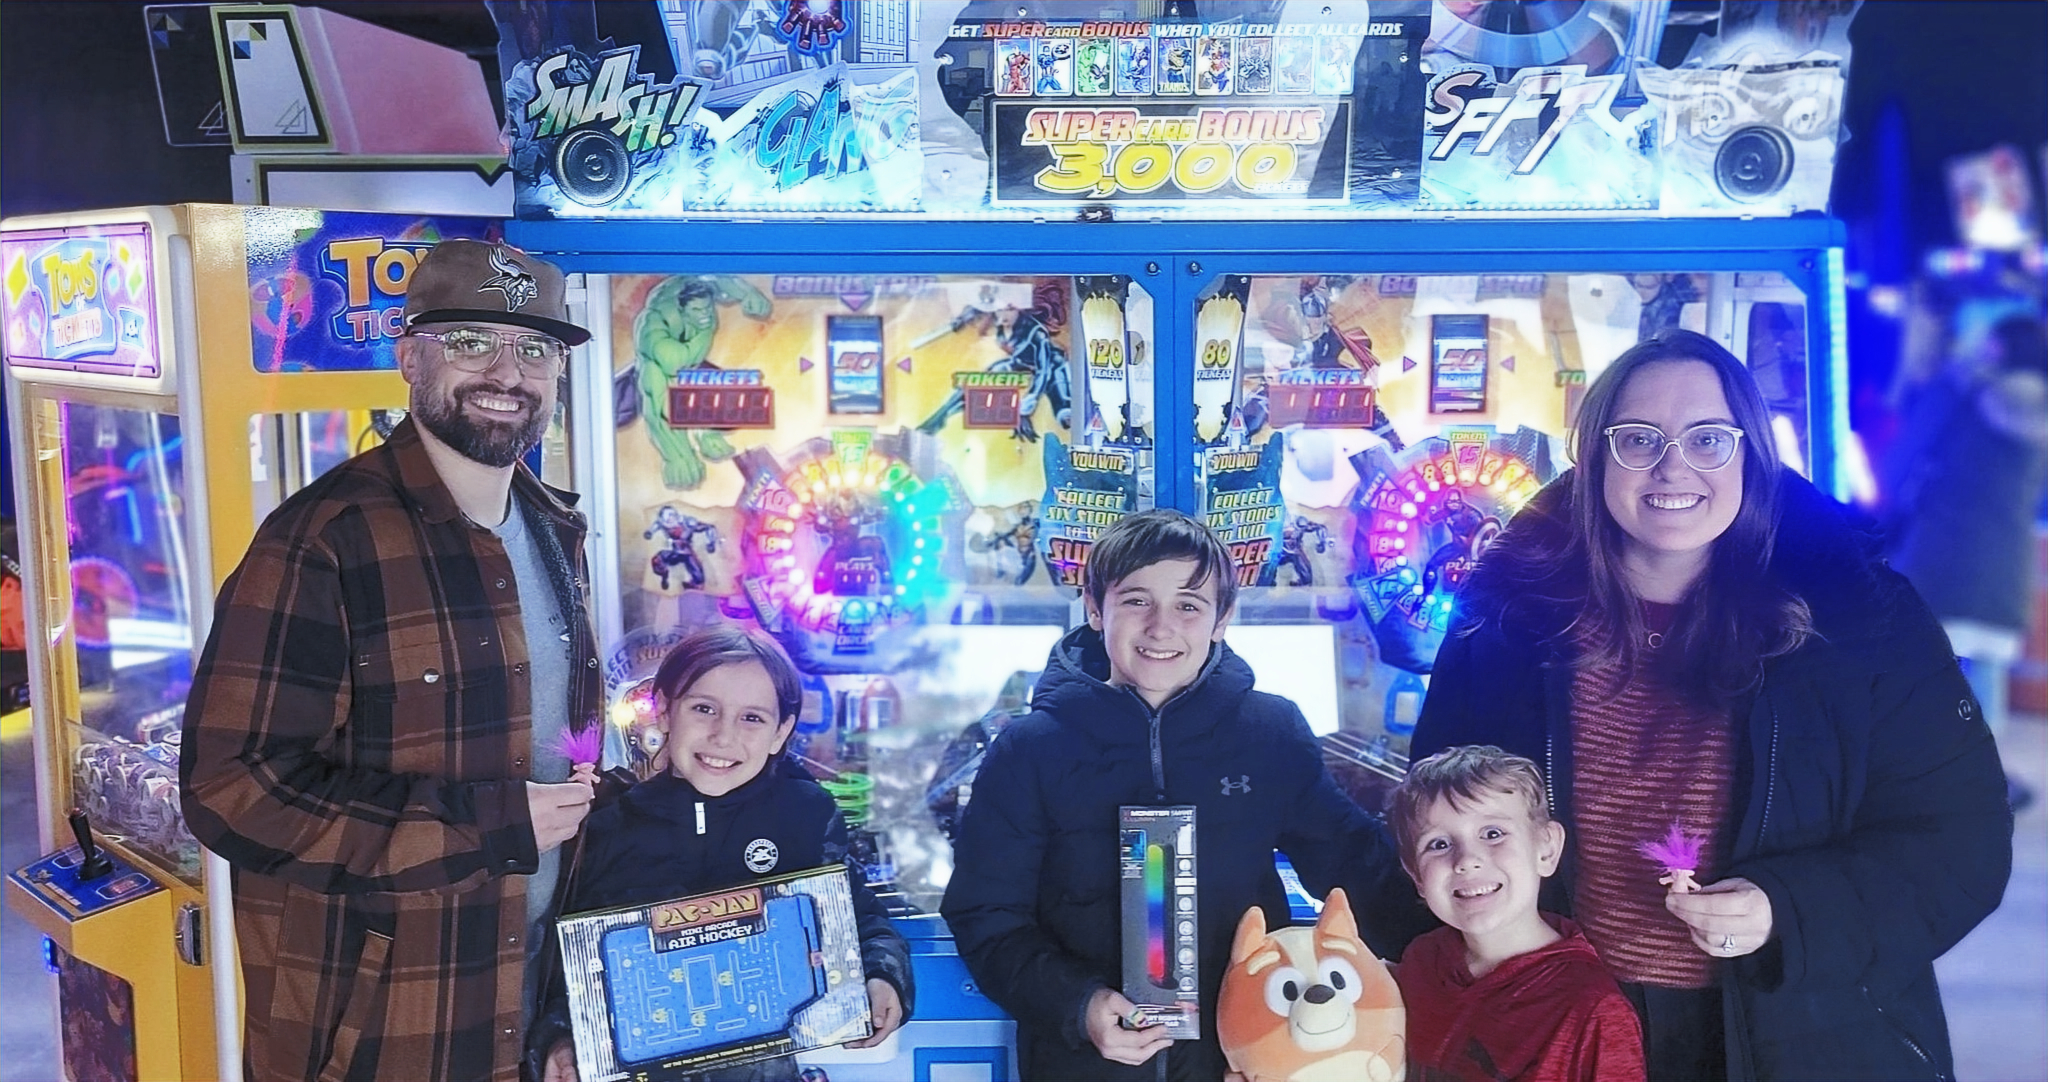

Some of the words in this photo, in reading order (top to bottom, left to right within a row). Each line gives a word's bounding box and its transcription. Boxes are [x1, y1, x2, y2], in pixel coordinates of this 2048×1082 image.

[948, 24, 981, 37] GET
[1155, 23, 1202, 36] WHEN
[1208, 23, 1243, 36] YOU
[1246, 23, 1312, 36] COLLECT
[1317, 23, 1346, 36] ALL
[1349, 23, 1404, 36] CARDS
[526, 51, 702, 152] SMASH!
[1037, 142, 1298, 196] 3,000
[773, 275, 870, 295] BONUS
[1089, 338, 1124, 369] 120
[1201, 338, 1232, 369] 80
[677, 369, 762, 386] TICKETS
[954, 372, 1032, 387] TOKENS
[1279, 369, 1363, 385] TICKETS
[1072, 451, 1097, 469] YOU
[1213, 453, 1237, 470] YOU
[1236, 452, 1259, 468] WIN
[1057, 489, 1126, 509] COLLECT
[1213, 489, 1274, 509] COLLECT
[1047, 506, 1072, 521] SIX
[1075, 508, 1126, 524] STON
[1230, 505, 1283, 524] STONES
[1237, 523, 1266, 539] WIN
[1228, 541, 1272, 564] PER
[667, 936, 697, 950] AIR
[699, 924, 753, 944] HOCKEY
[680, 926, 704, 937] MINI
[703, 919, 739, 932] ARCADE
